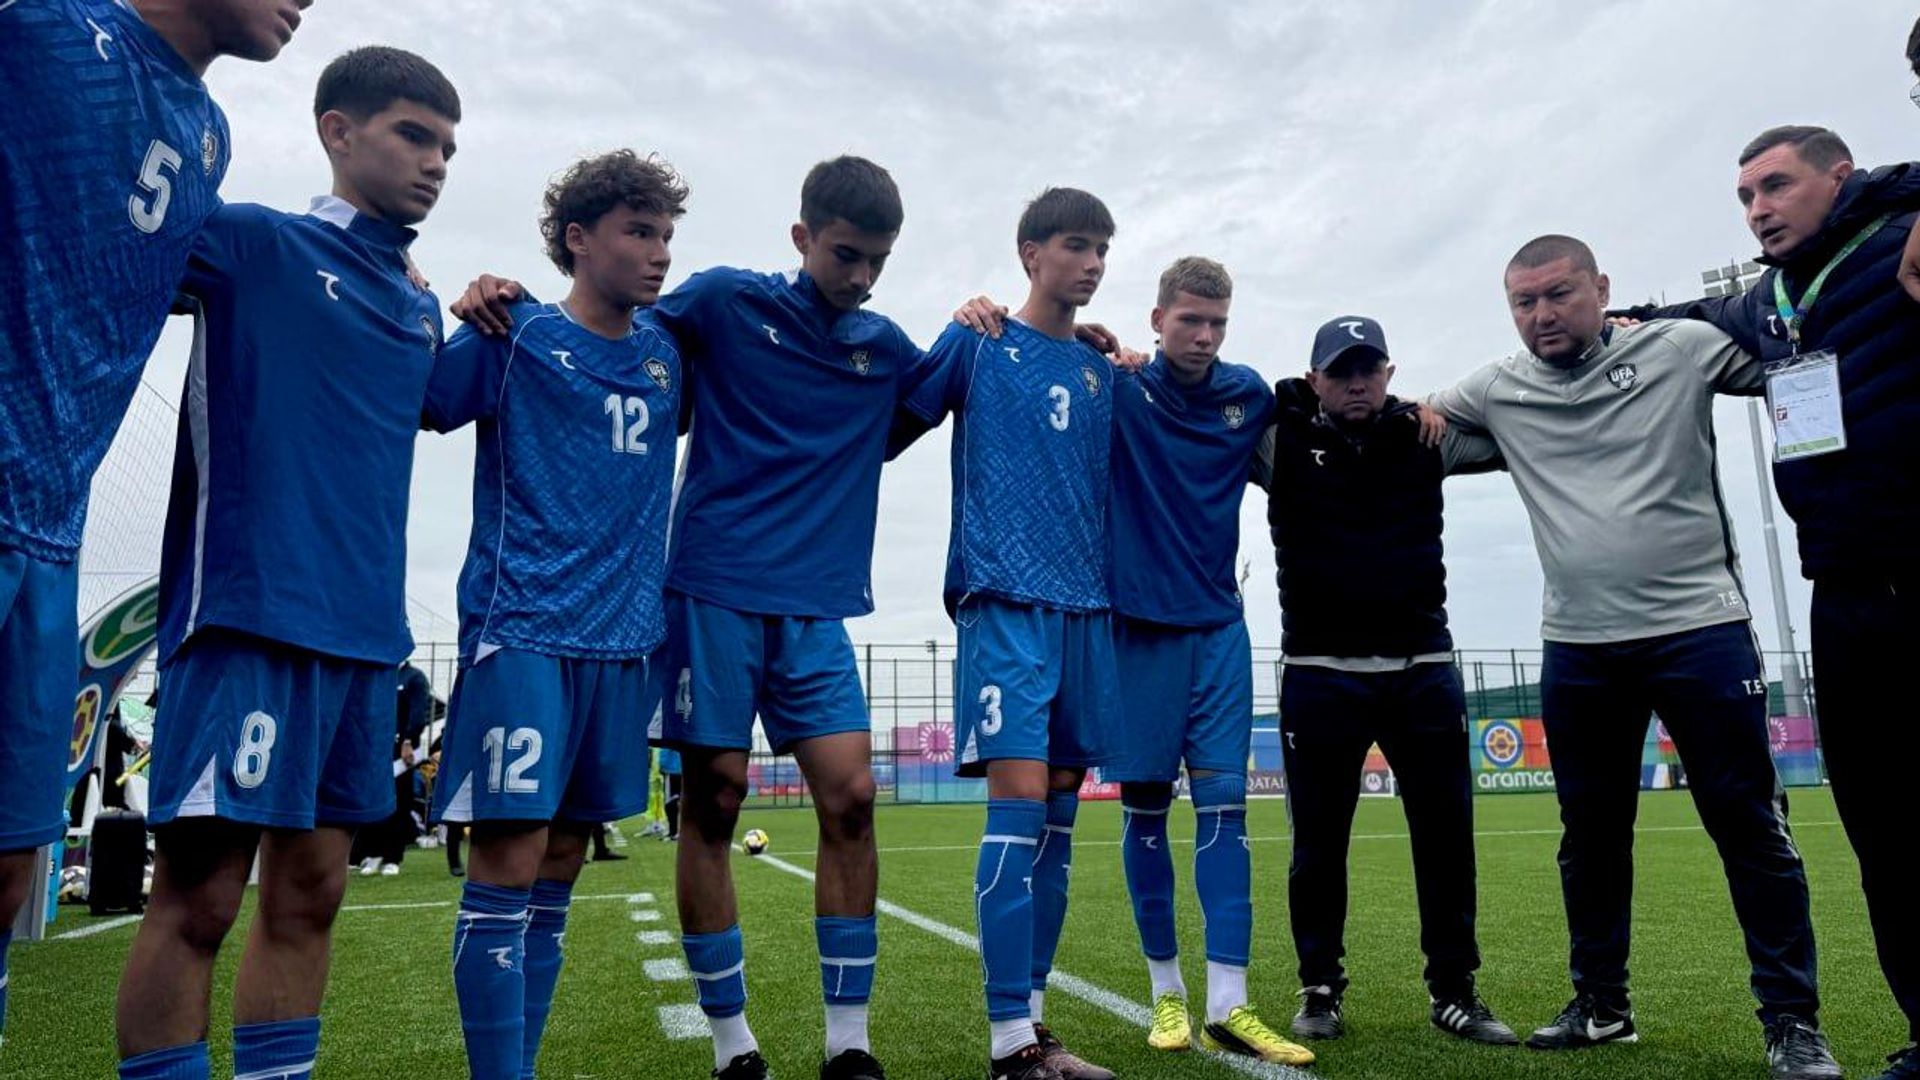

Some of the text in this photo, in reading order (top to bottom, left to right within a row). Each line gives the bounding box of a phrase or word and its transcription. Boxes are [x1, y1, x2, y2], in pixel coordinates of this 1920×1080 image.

[128, 139, 183, 234] 5
[1610, 366, 1635, 383] UFA
[604, 393, 649, 455] 12
[1048, 385, 1071, 431] 3
[979, 685, 1002, 736] 3
[1741, 680, 1764, 695] T.E
[233, 709, 277, 789] 8
[482, 726, 543, 793] 12
